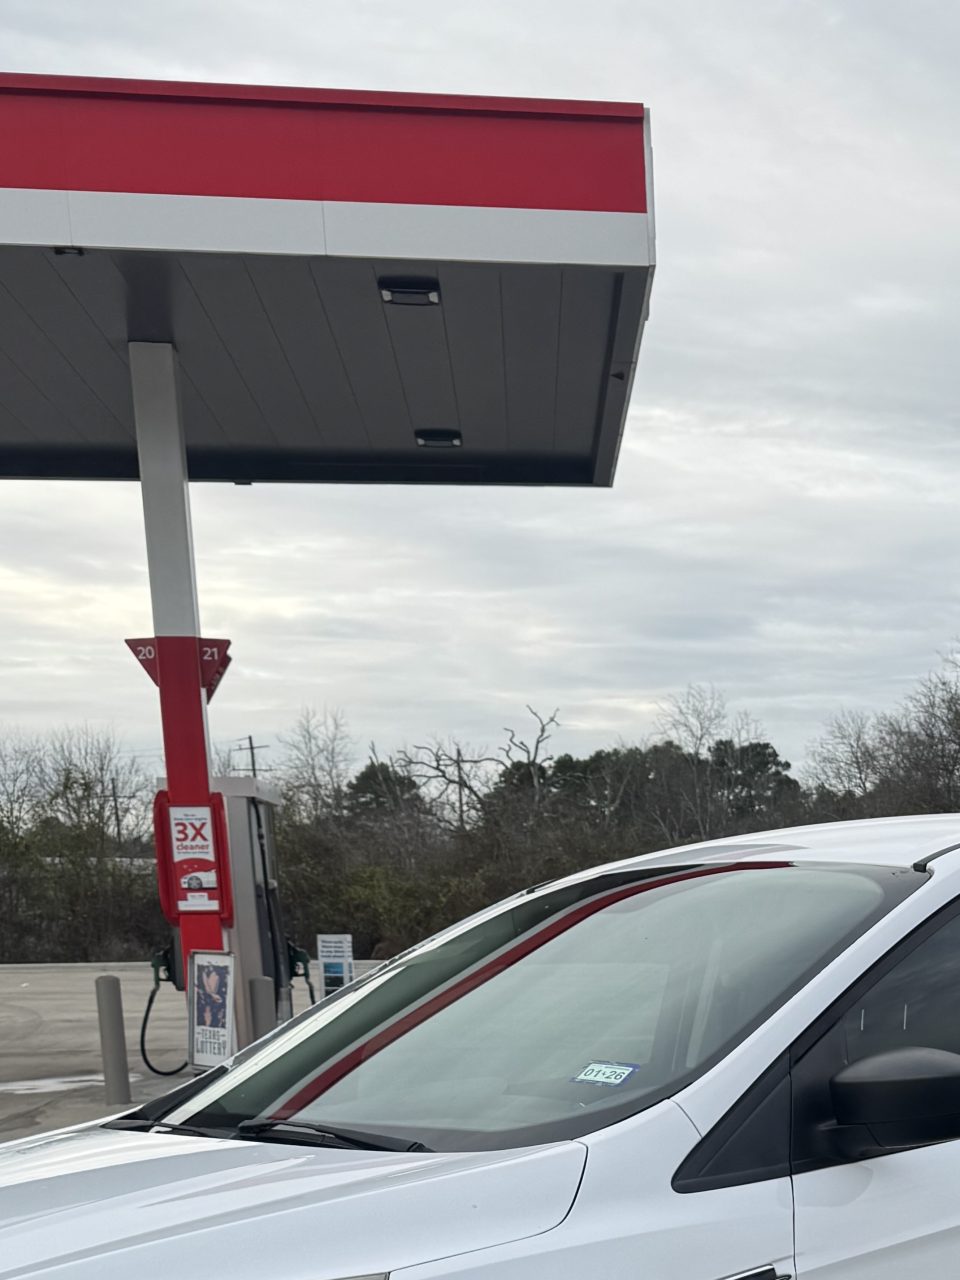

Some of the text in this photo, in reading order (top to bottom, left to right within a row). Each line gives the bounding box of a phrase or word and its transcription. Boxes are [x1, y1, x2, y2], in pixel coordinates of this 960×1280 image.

[136, 646, 155, 660] 20
[202, 647, 219, 660] 21
[174, 821, 209, 842] 3X
[176, 843, 209, 851] cleaner
[196, 1037, 227, 1056] LOTTERY
